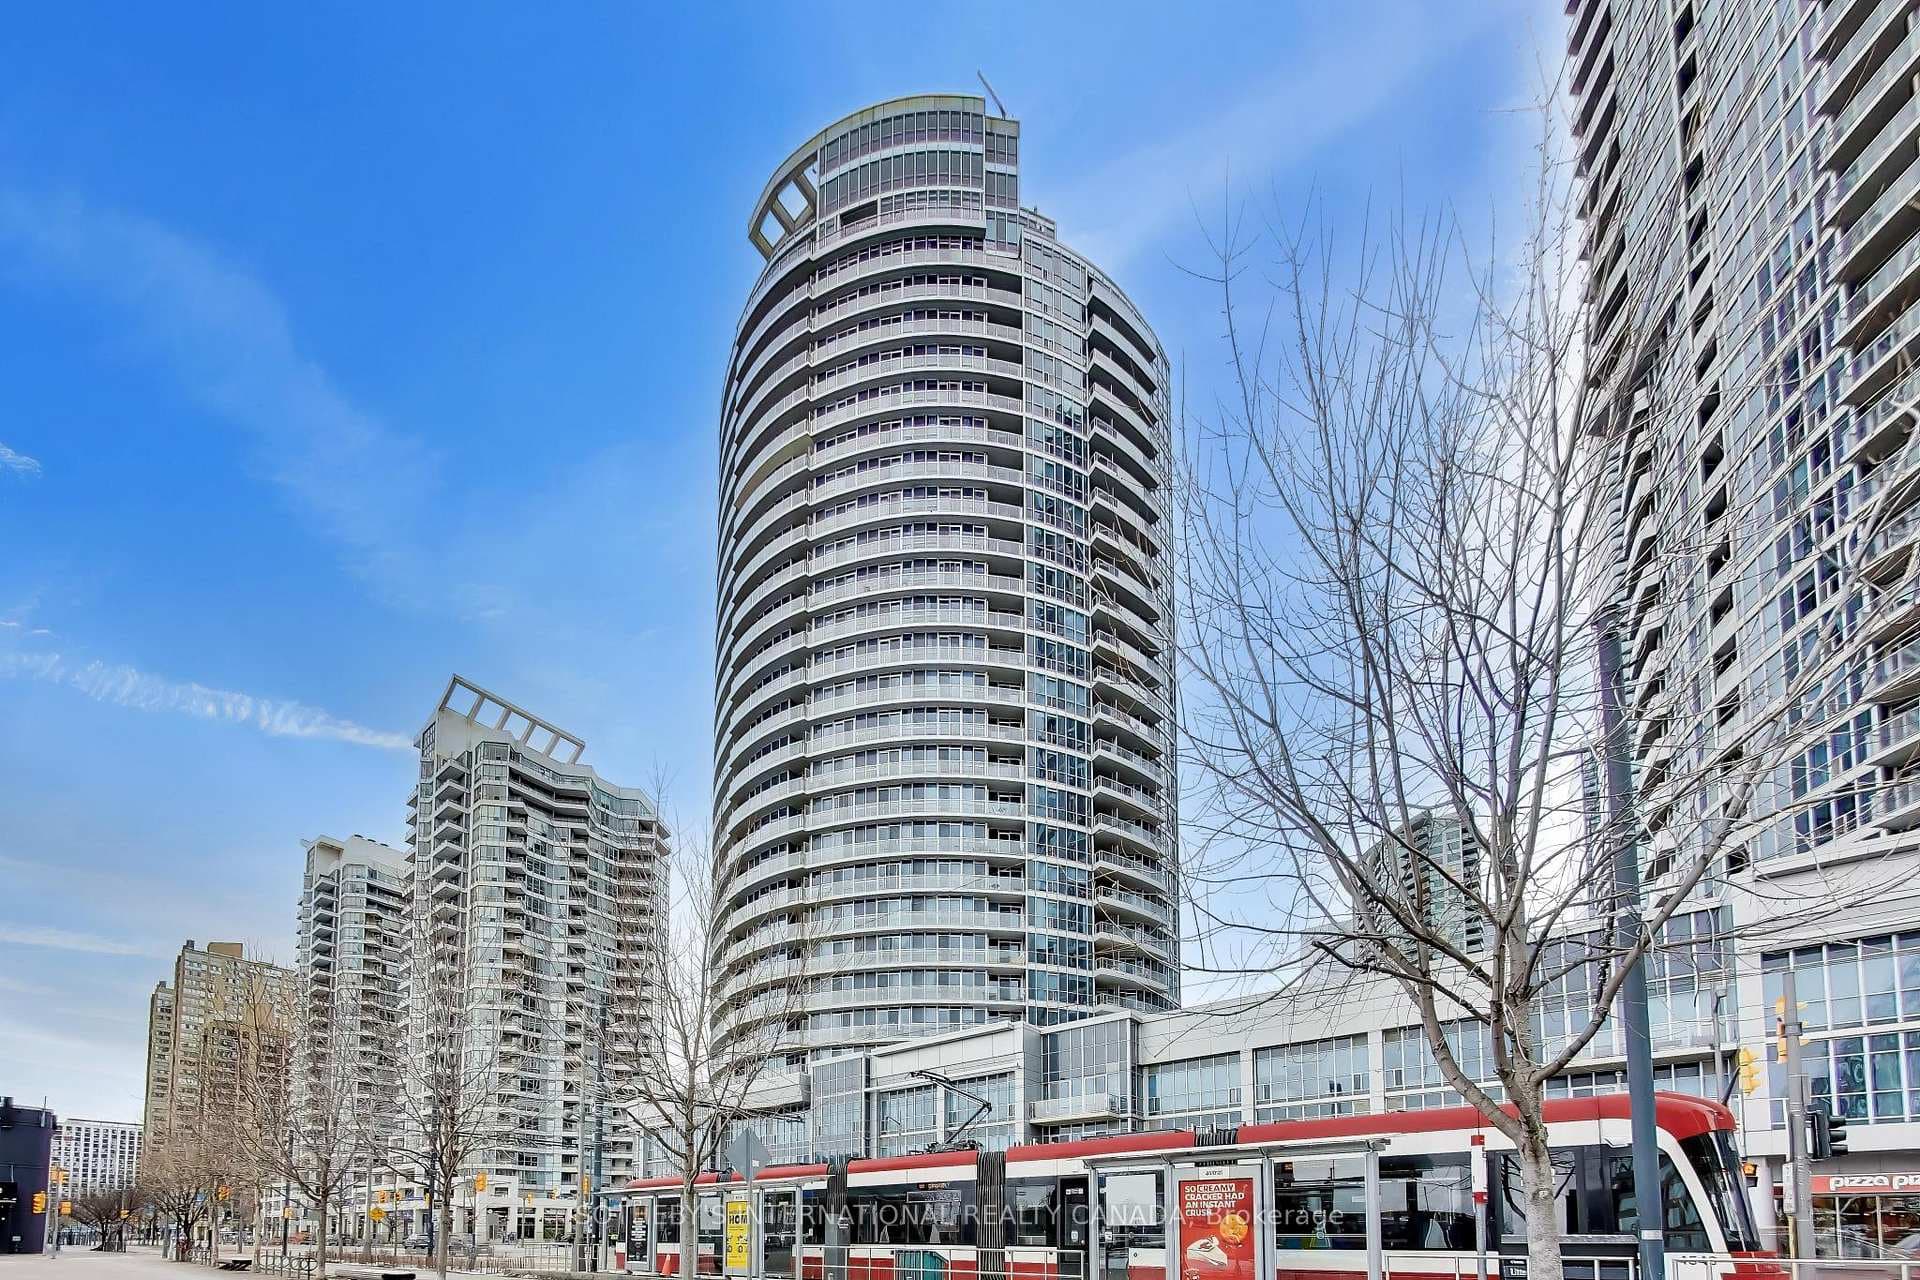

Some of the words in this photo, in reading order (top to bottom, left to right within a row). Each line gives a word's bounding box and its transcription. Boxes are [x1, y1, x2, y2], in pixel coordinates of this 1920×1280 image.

[1829, 1175, 1889, 1191] pizza
[1184, 1185, 1196, 1193] SO
[1197, 1184, 1234, 1192] CREAMY
[1184, 1193, 1223, 1201] CRACKER
[1224, 1192, 1245, 1200] HAD
[1185, 1201, 1198, 1209] AN
[1200, 1200, 1236, 1208] INSTANT
[1185, 1209, 1212, 1217] CRUSH
[729, 1214, 748, 1225] HOM
